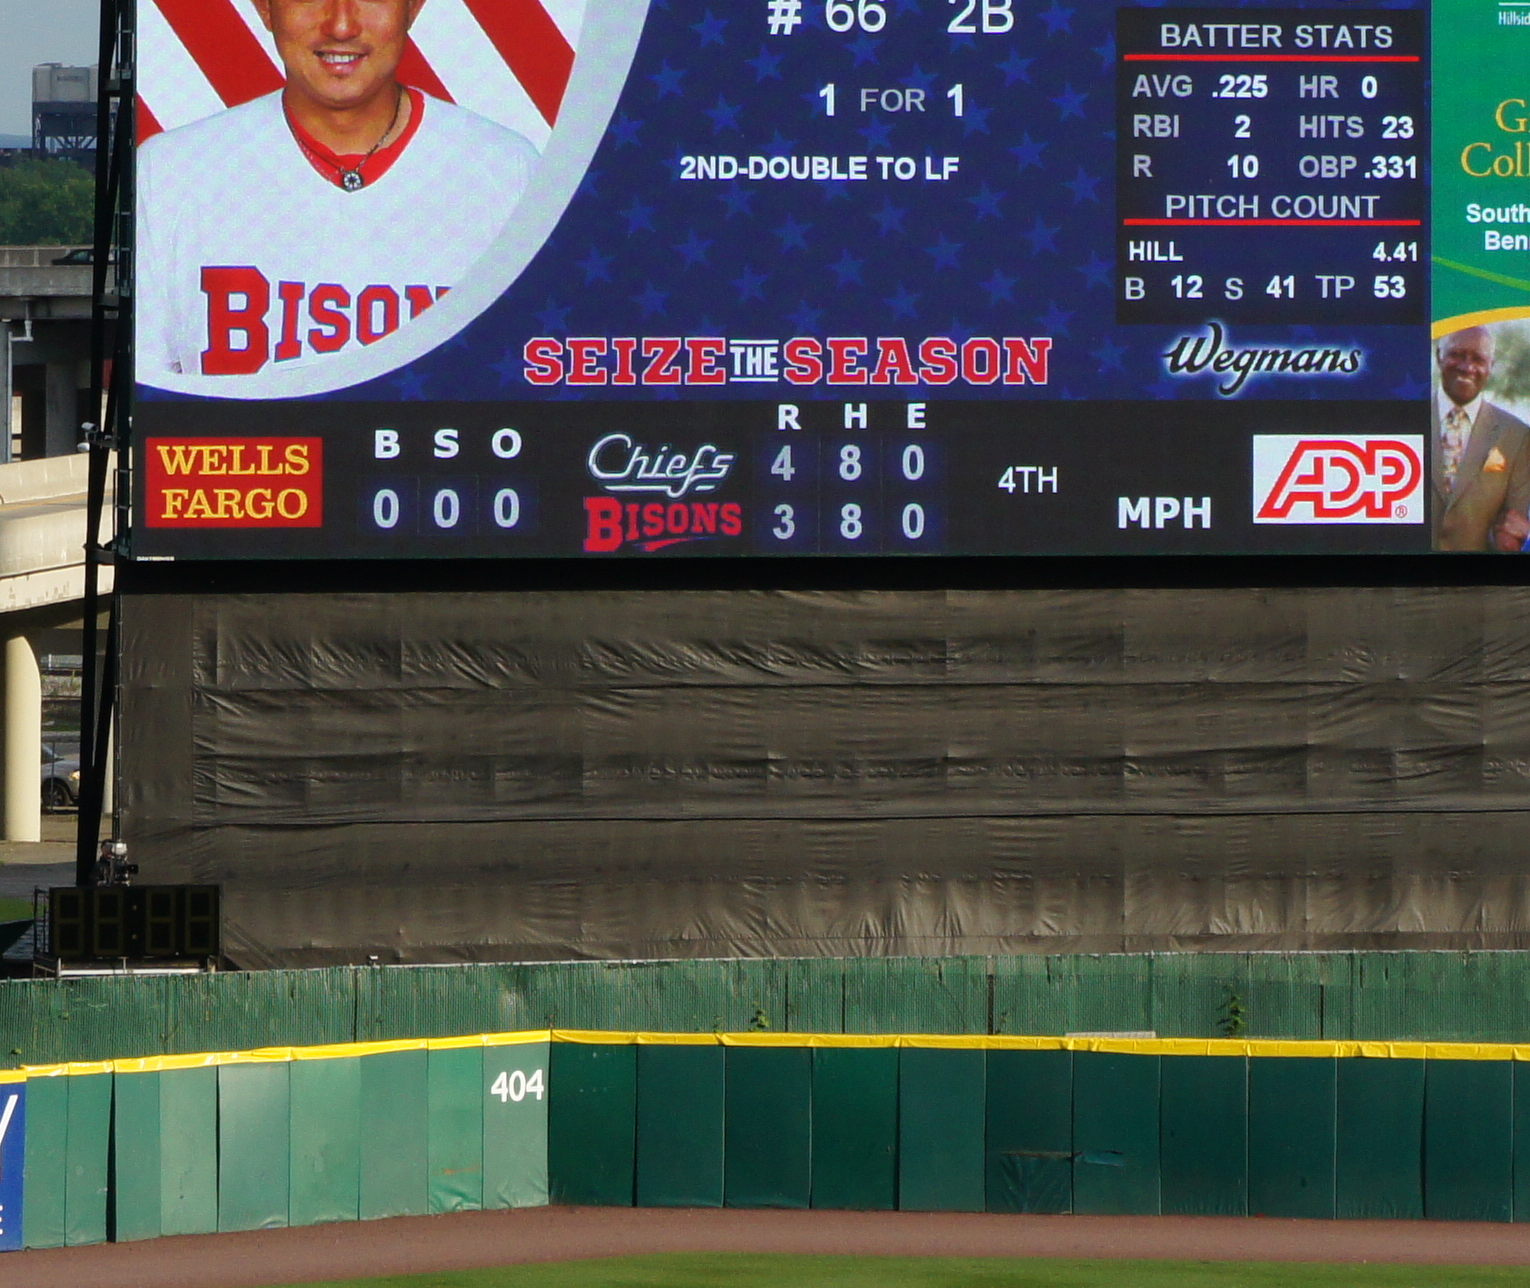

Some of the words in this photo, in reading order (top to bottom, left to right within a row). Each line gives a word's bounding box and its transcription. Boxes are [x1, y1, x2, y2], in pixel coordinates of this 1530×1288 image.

[1160, 24, 1282, 48] BATTER
[1294, 25, 1393, 48] STATS
[818, 83, 835, 116] 1
[860, 89, 926, 112] FOR
[947, 83, 963, 117] 1
[1132, 74, 1193, 98] AVG
[1212, 74, 1268, 98] .225
[1299, 75, 1339, 98] HR
[1361, 76, 1378, 98] 0
[1133, 114, 1180, 138] RBI
[1234, 115, 1251, 138] 2
[1299, 115, 1364, 138] HITS
[1382, 116, 1414, 139] 23
[680, 155, 867, 180] 2ND-DOUBLE
[876, 156, 916, 180] TO
[925, 157, 959, 180] LF
[1133, 154, 1153, 178] R
[1227, 155, 1259, 178] 10
[1299, 155, 1357, 178] OBP
[1364, 156, 1417, 179] .331
[1166, 195, 1259, 218] PITCH
[1271, 195, 1380, 219] COUNT
[1129, 241, 1184, 261] HILL
[1372, 241, 1418, 262] 4.41
[1125, 277, 1146, 300] B
[1171, 275, 1203, 298] 12
[1225, 277, 1244, 300] S
[1266, 275, 1295, 298] 41
[1315, 275, 1355, 299] TP
[1374, 275, 1406, 298] 53
[523, 337, 726, 385] SEIZE
[729, 345, 779, 376] THE
[783, 337, 1053, 385] SEASON
[1162, 323, 1362, 395] Wegmans
[778, 404, 801, 430] R
[845, 403, 867, 429] H
[907, 403, 926, 429] E
[374, 429, 400, 459] B
[433, 429, 460, 460] S
[492, 428, 522, 459] O
[157, 445, 311, 475] WELLS
[588, 433, 734, 498] Chiefs
[771, 445, 795, 481] 4
[839, 445, 862, 481] 8
[902, 445, 925, 481] 0
[998, 466, 1058, 493] 4TH
[1256, 440, 1422, 519] ADP
[161, 489, 309, 519] FARGO
[374, 489, 400, 529] 0
[434, 489, 460, 529] 0
[493, 488, 520, 528] 0
[1117, 497, 1211, 529] MPH
[583, 497, 742, 552] BISONS
[773, 504, 795, 540] 3
[840, 504, 863, 540] 8
[902, 503, 925, 540] 0
[491, 1069, 544, 1103] 404
